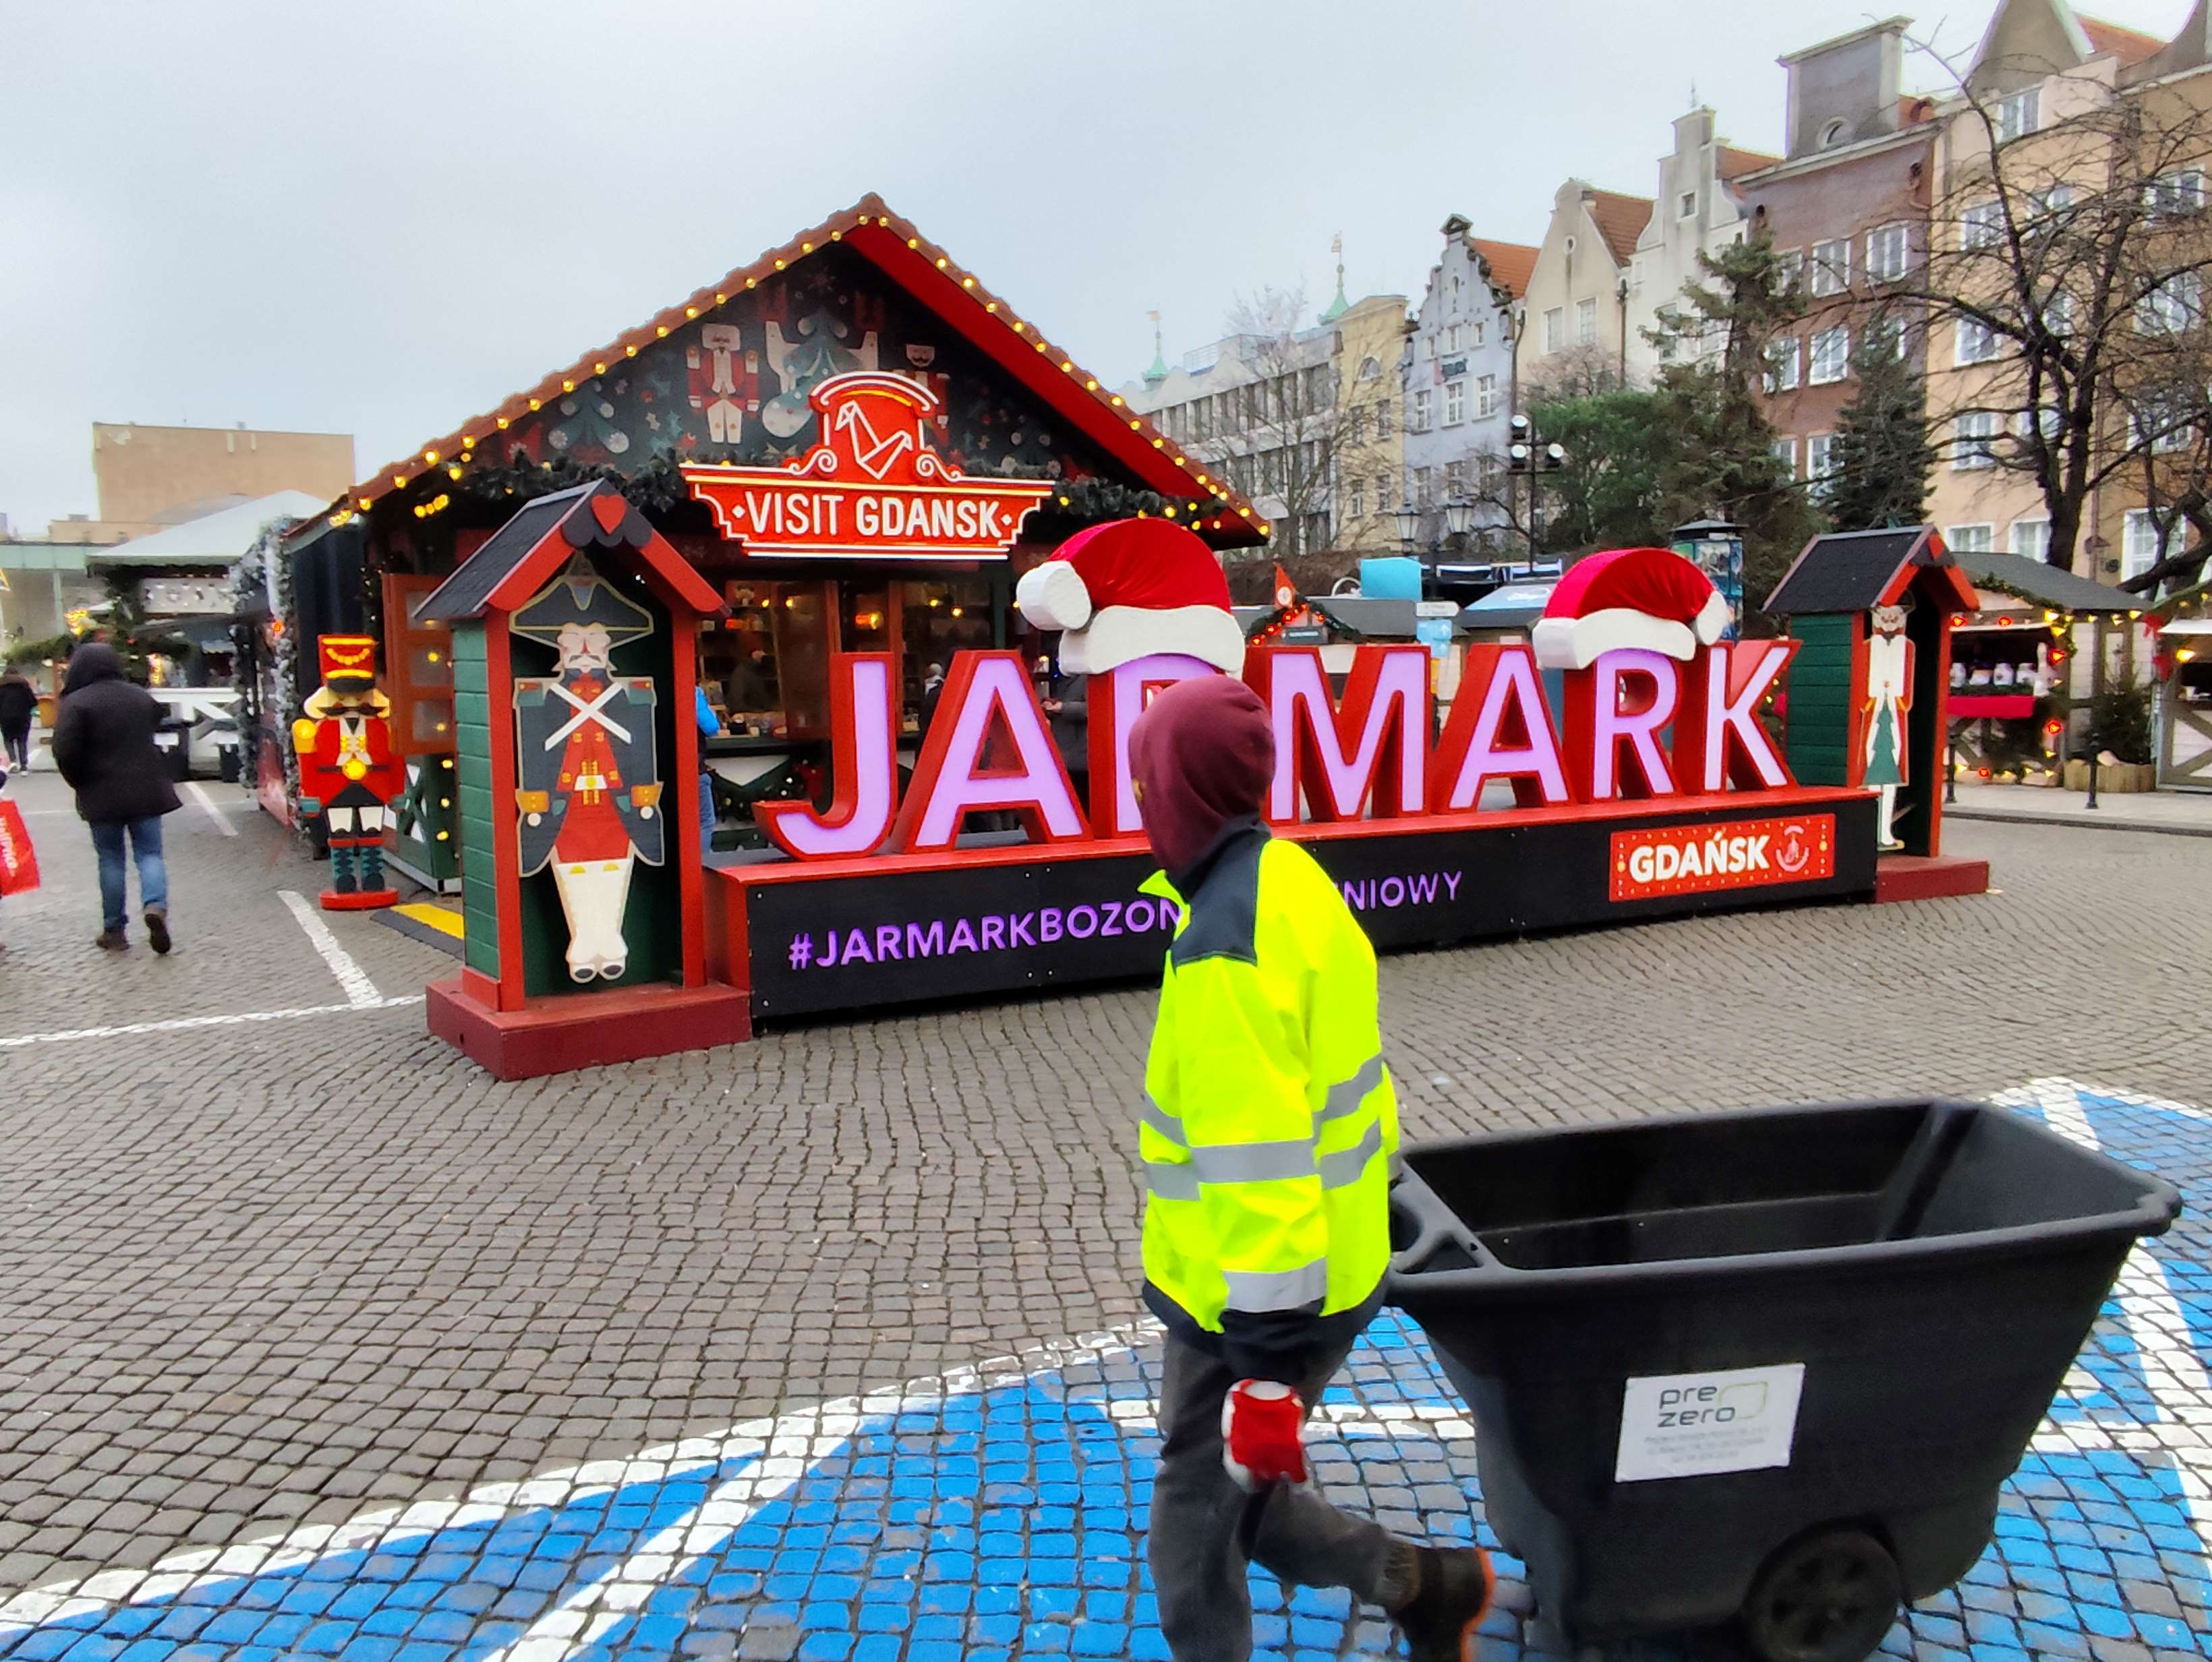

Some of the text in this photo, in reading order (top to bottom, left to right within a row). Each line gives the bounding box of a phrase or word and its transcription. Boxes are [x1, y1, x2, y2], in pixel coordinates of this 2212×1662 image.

[745, 490, 1003, 538] VISIT GDANSK
[1629, 829, 1771, 884] GDAŃSK
[1658, 1385, 1718, 1409] pre
[1657, 1406, 1736, 1428] zero
